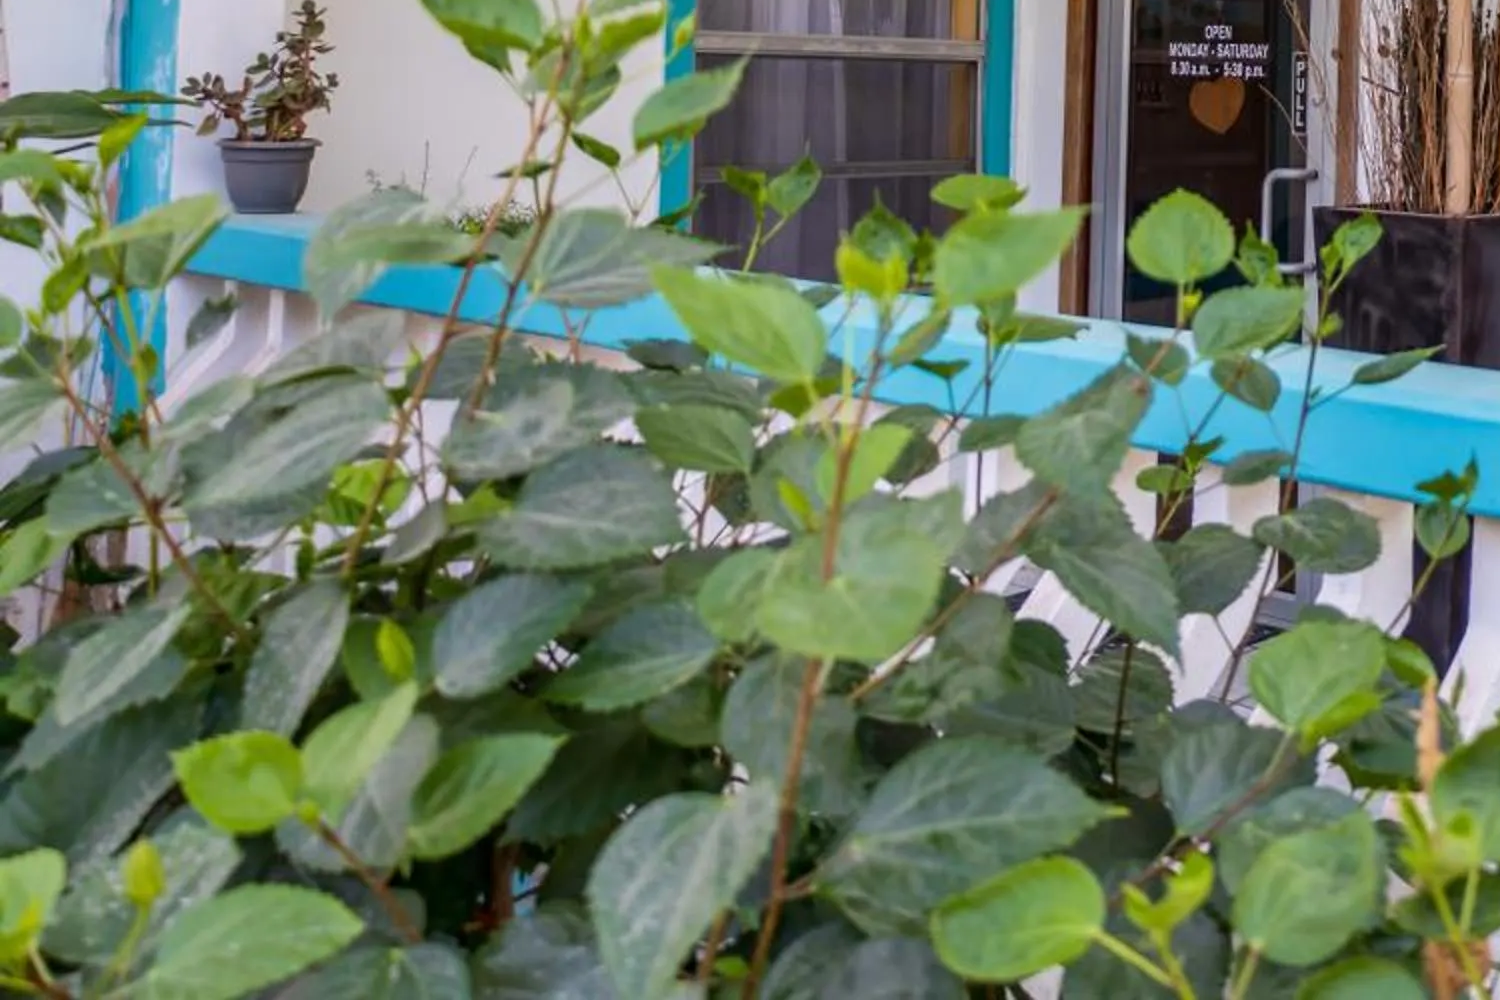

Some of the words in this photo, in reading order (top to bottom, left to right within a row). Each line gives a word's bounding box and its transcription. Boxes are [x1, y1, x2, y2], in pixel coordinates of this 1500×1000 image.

[1204, 25, 1233, 41] OPEN
[1169, 42, 1210, 58] MONDAY
[1216, 43, 1269, 59] SATURDAY
[1295, 61, 1305, 127] PULL
